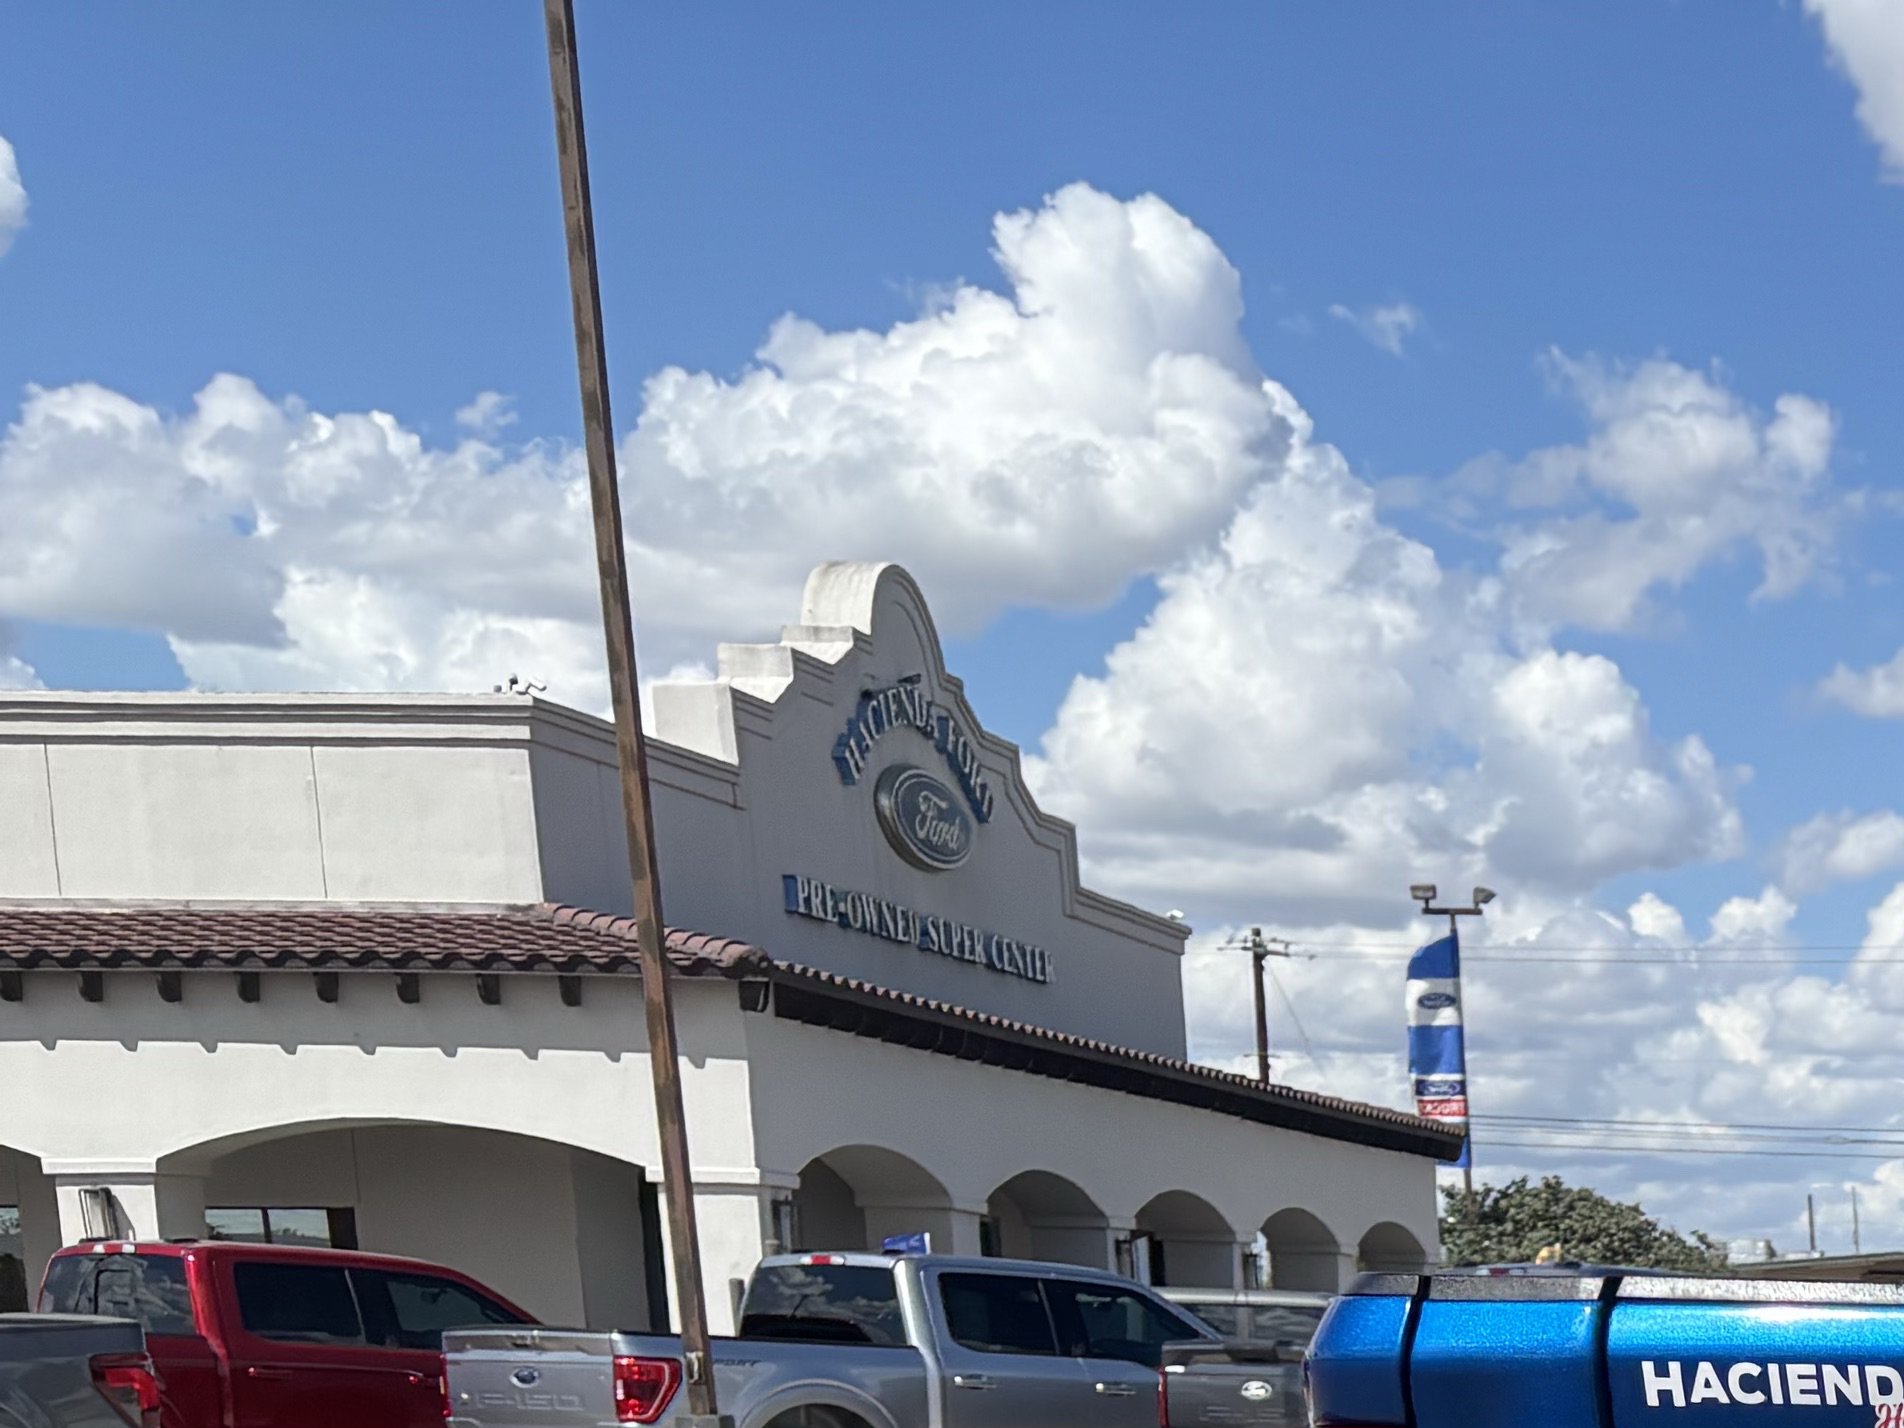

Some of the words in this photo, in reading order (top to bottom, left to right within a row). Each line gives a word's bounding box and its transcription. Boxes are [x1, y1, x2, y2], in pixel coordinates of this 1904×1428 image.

[843, 684, 940, 781] HACIENDA
[946, 718, 993, 817] FORD
[914, 790, 962, 851] Ford
[796, 874, 920, 945] PRE-OWNED
[927, 915, 988, 965] SUPER
[990, 933, 1056, 985] CENTER
